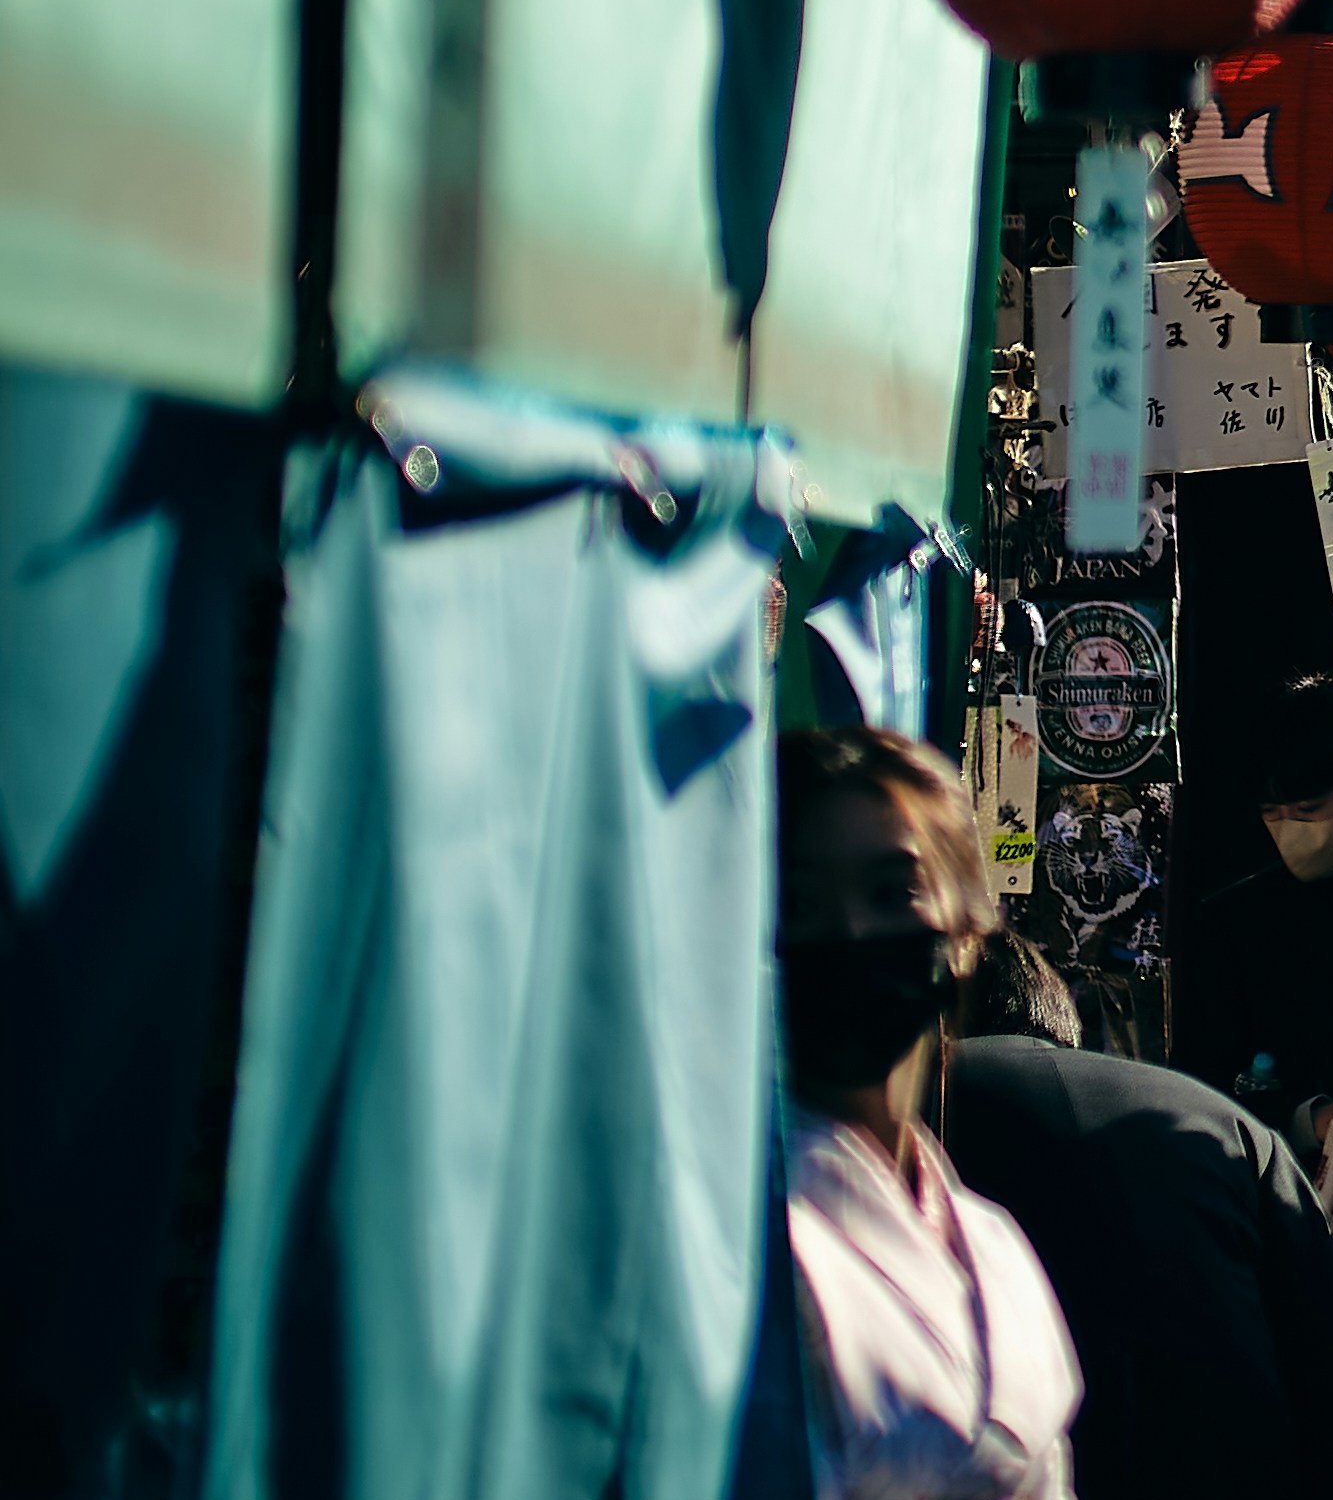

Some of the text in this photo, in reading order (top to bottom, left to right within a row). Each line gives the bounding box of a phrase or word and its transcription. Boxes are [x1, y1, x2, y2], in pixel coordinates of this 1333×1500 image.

[1213, 376, 1283, 403] ヤマト
[1050, 556, 1142, 585] JAPAN
[1048, 680, 1153, 704] Shimuraken
